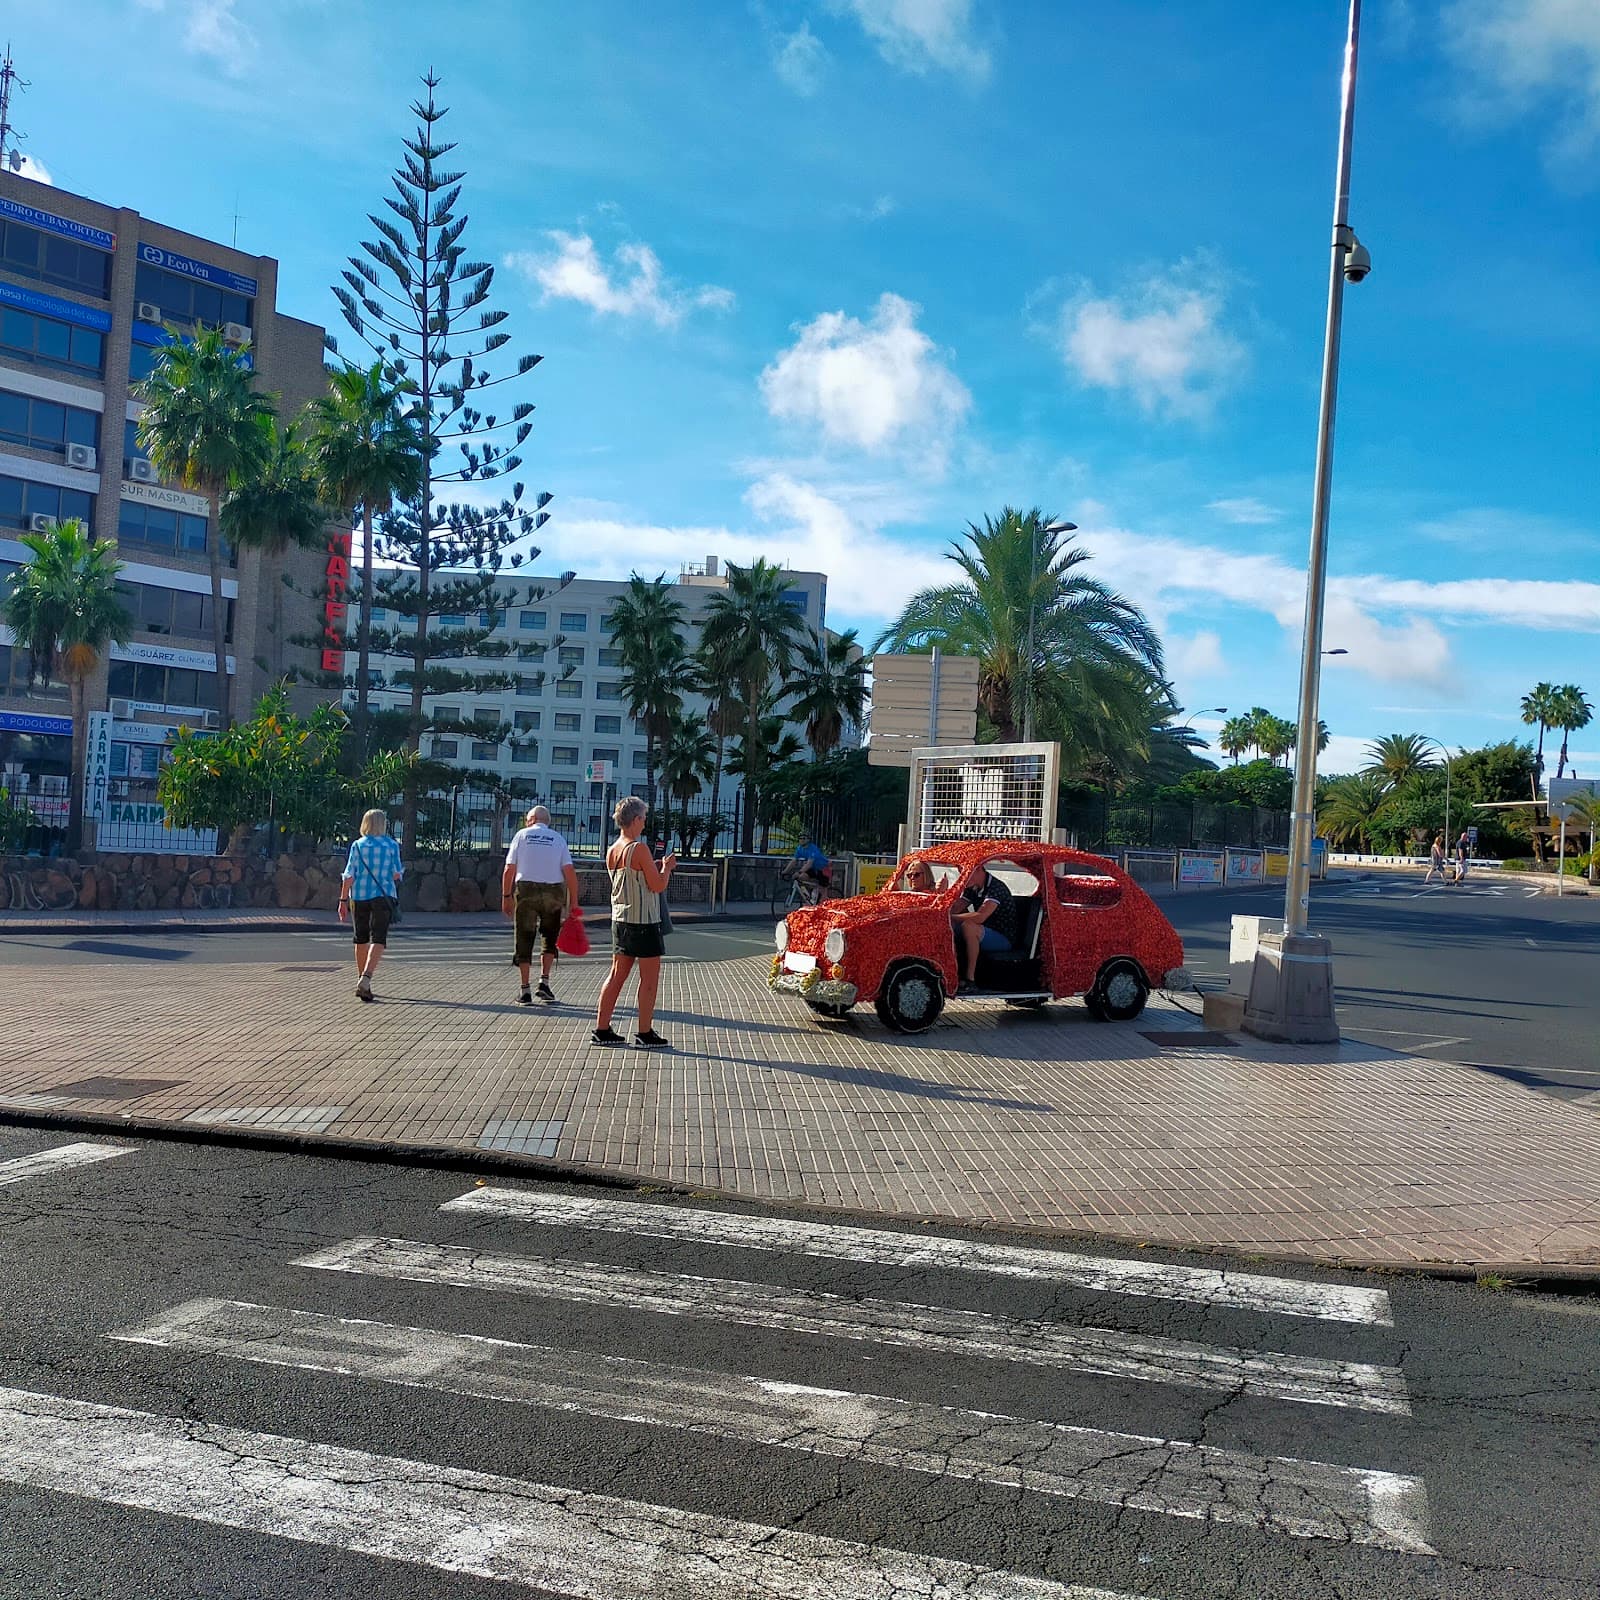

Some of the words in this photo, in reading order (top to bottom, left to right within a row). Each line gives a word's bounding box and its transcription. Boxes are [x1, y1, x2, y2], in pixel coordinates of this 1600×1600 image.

[35, 212, 68, 229] CUBAS
[69, 223, 111, 243] ORTEGA
[167, 255, 209, 279] EcoVen
[120, 483, 144, 497] SUR
[147, 489, 188, 506] MASPA
[140, 648, 175, 661] SUÁREZ
[95, 718, 107, 811] FARMACIA
